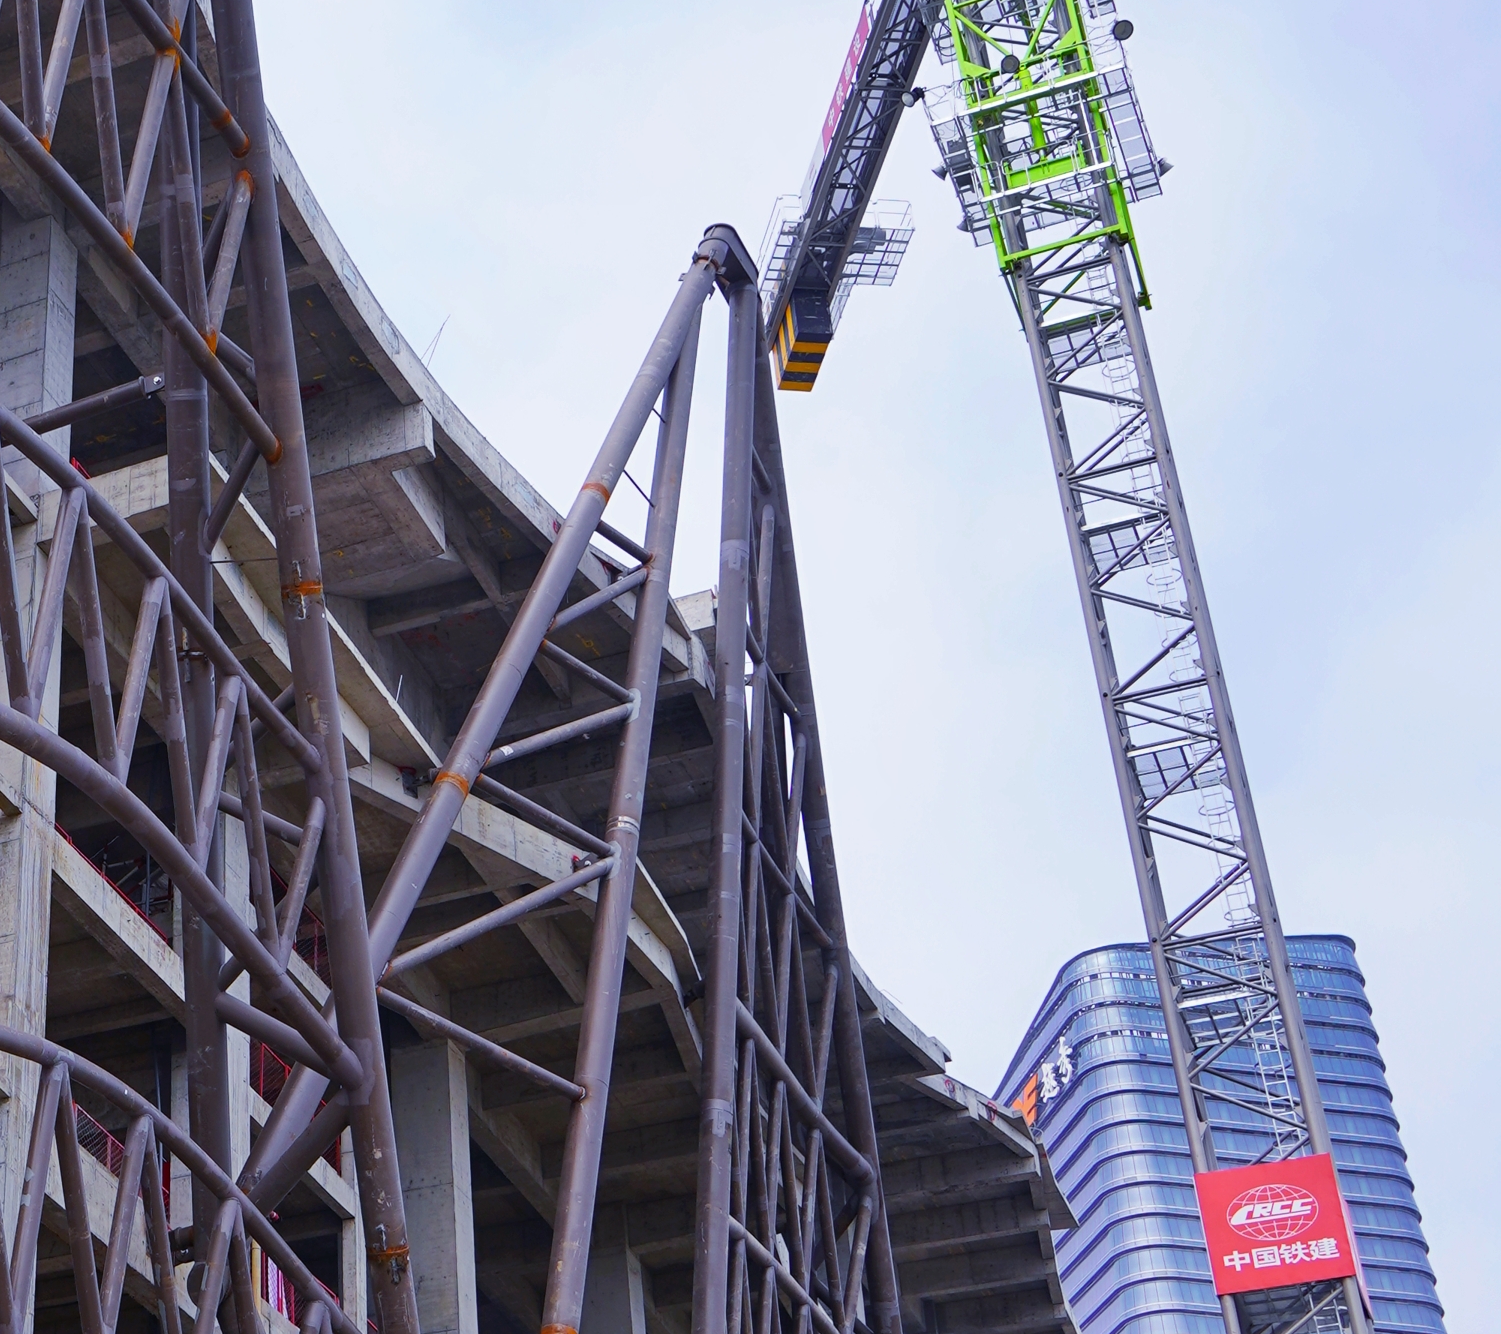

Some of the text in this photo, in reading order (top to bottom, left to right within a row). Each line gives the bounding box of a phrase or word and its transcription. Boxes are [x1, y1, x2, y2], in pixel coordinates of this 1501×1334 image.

[1230, 1198, 1314, 1226] CRCC
[1223, 1237, 1340, 1272] 中国铁建
